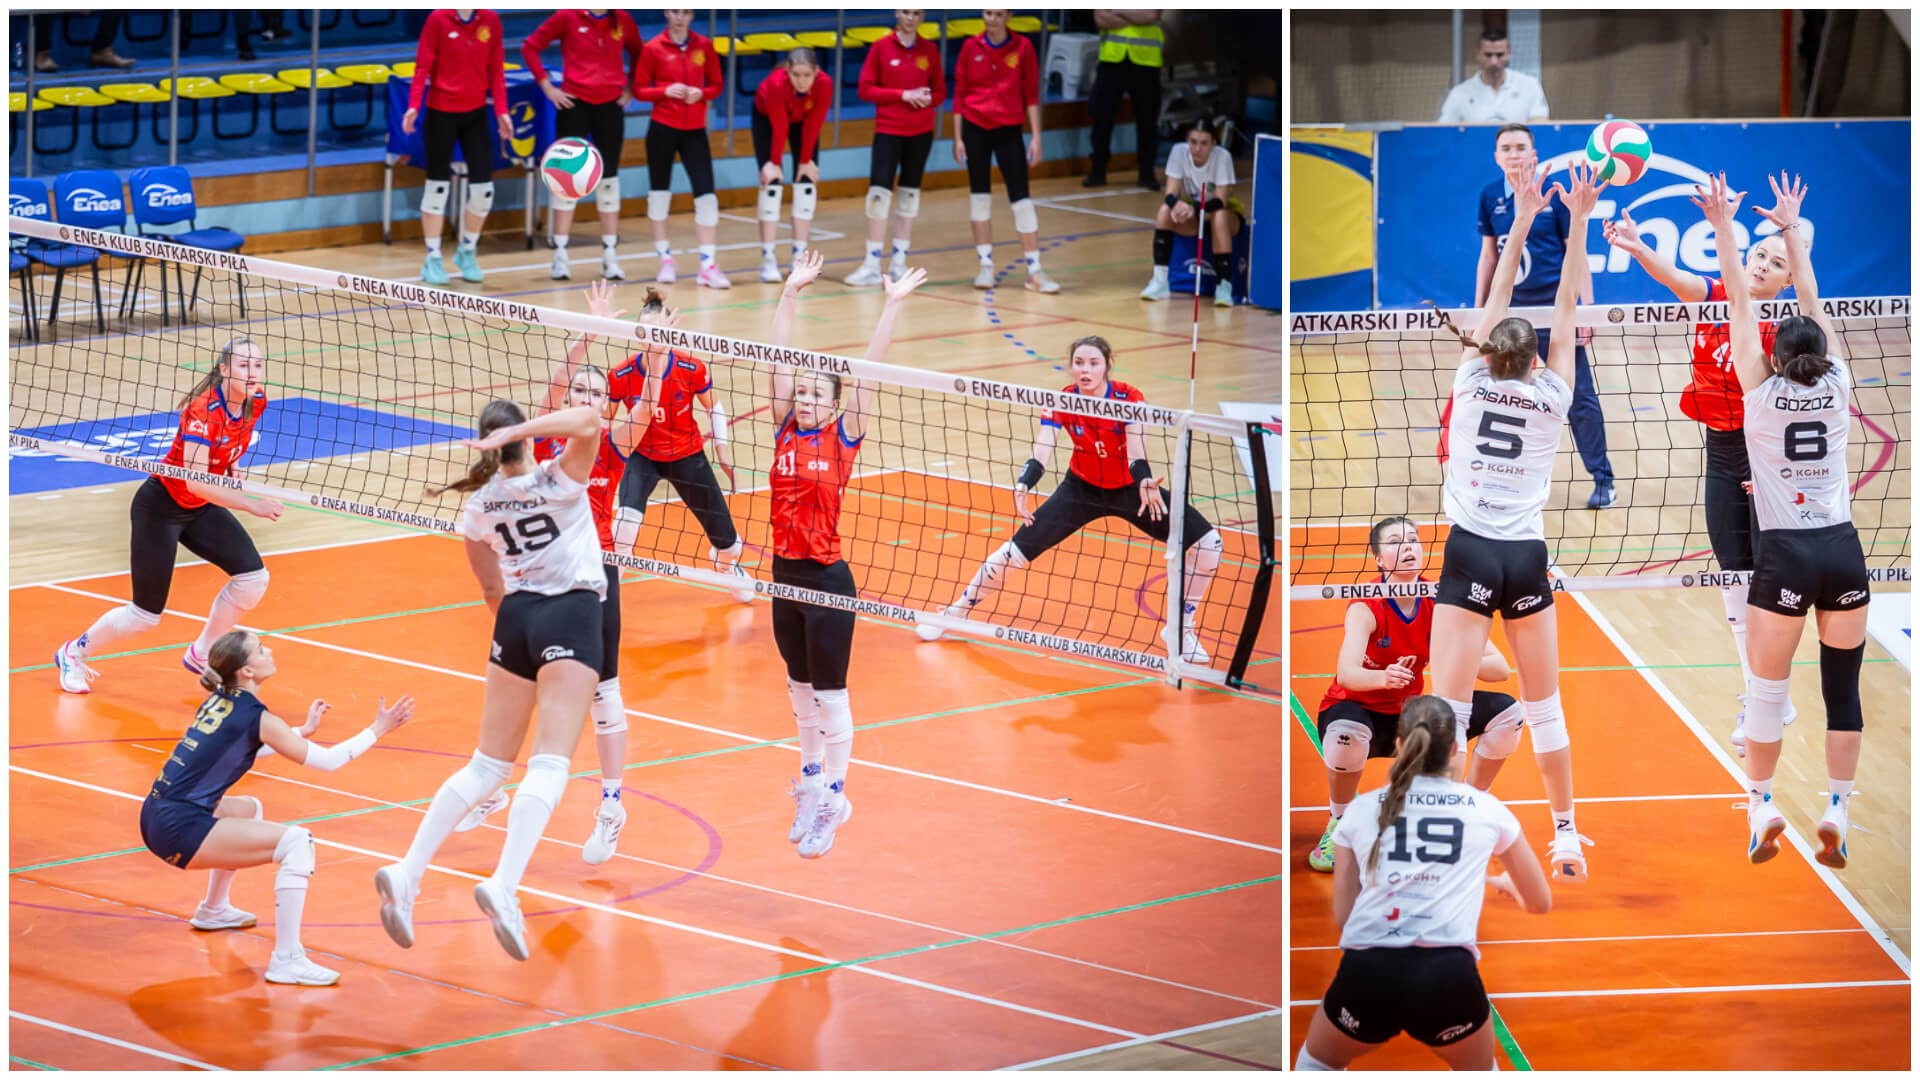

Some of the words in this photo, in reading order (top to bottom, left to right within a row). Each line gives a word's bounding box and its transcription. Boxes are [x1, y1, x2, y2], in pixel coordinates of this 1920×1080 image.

[9, 203, 47, 217] nea
[73, 197, 122, 212] Enea
[148, 192, 192, 207] Enea
[73, 229, 107, 247] ENEA
[110, 235, 142, 253] KLUB
[145, 241, 217, 266] SIATKARSKI
[220, 254, 249, 272] PIŁA
[352, 277, 388, 297] ENEA
[391, 284, 426, 303] KLUB
[429, 290, 506, 317] SIATKARSKI
[509, 303, 540, 322] PIŁA
[1633, 305, 1690, 323] ENEA
[1698, 304, 1730, 322] KLU
[1760, 299, 1882, 320] SIATARSKI
[1890, 298, 1909, 315] PI
[1291, 313, 1398, 332] ATKARSKI
[1406, 312, 1452, 329] PIŁA
[651, 328, 689, 348] ENEA
[692, 335, 730, 354] KLUB
[733, 341, 815, 369] SIATKARSKI
[819, 356, 852, 375] PIŁA
[972, 380, 1012, 401] ENEA
[1016, 387, 1055, 408] KLUB
[1060, 395, 1148, 422] SIATKARSKI
[1152, 409, 1176, 426] PIŁ
[1473, 386, 1553, 414] PISARSKA
[20, 436, 40, 450] PIŁA
[1475, 410, 1527, 460] 5
[1784, 421, 1828, 462] 6
[115, 457, 139, 469] ENEA
[142, 462, 166, 475] KLUB
[168, 467, 220, 486] SIATKARSKI
[222, 477, 243, 491] PIŁA
[777, 450, 796, 476] 41
[1487, 463, 1525, 475] KGHM
[1796, 468, 1829, 477] KGHM
[321, 497, 347, 511] ENEA
[350, 502, 374, 516] KLUB
[376, 506, 432, 528] SIATKARSKI
[434, 516, 456, 532] PIŁA
[494, 512, 560, 556] 19
[602, 552, 655, 572] IATKARSKI
[657, 562, 680, 577] PIŁA
[1887, 568, 1911, 581] PIŁ
[1341, 584, 1385, 598] ENEA
[1388, 583, 1429, 597] KLUB
[1700, 573, 1742, 587] ENEA
[767, 583, 795, 599] ENEA
[798, 590, 826, 604] KLUB
[828, 595, 889, 617] SIATKARSKI
[891, 607, 916, 622] PIŁA
[1008, 629, 1037, 645] ENEA
[1040, 635, 1070, 651] KLUB
[1072, 641, 1137, 664] SIATKARSKI
[1139, 655, 1165, 670] PIŁA
[1378, 793, 1476, 808] BTKOWSKA
[1387, 816, 1464, 865] 19
